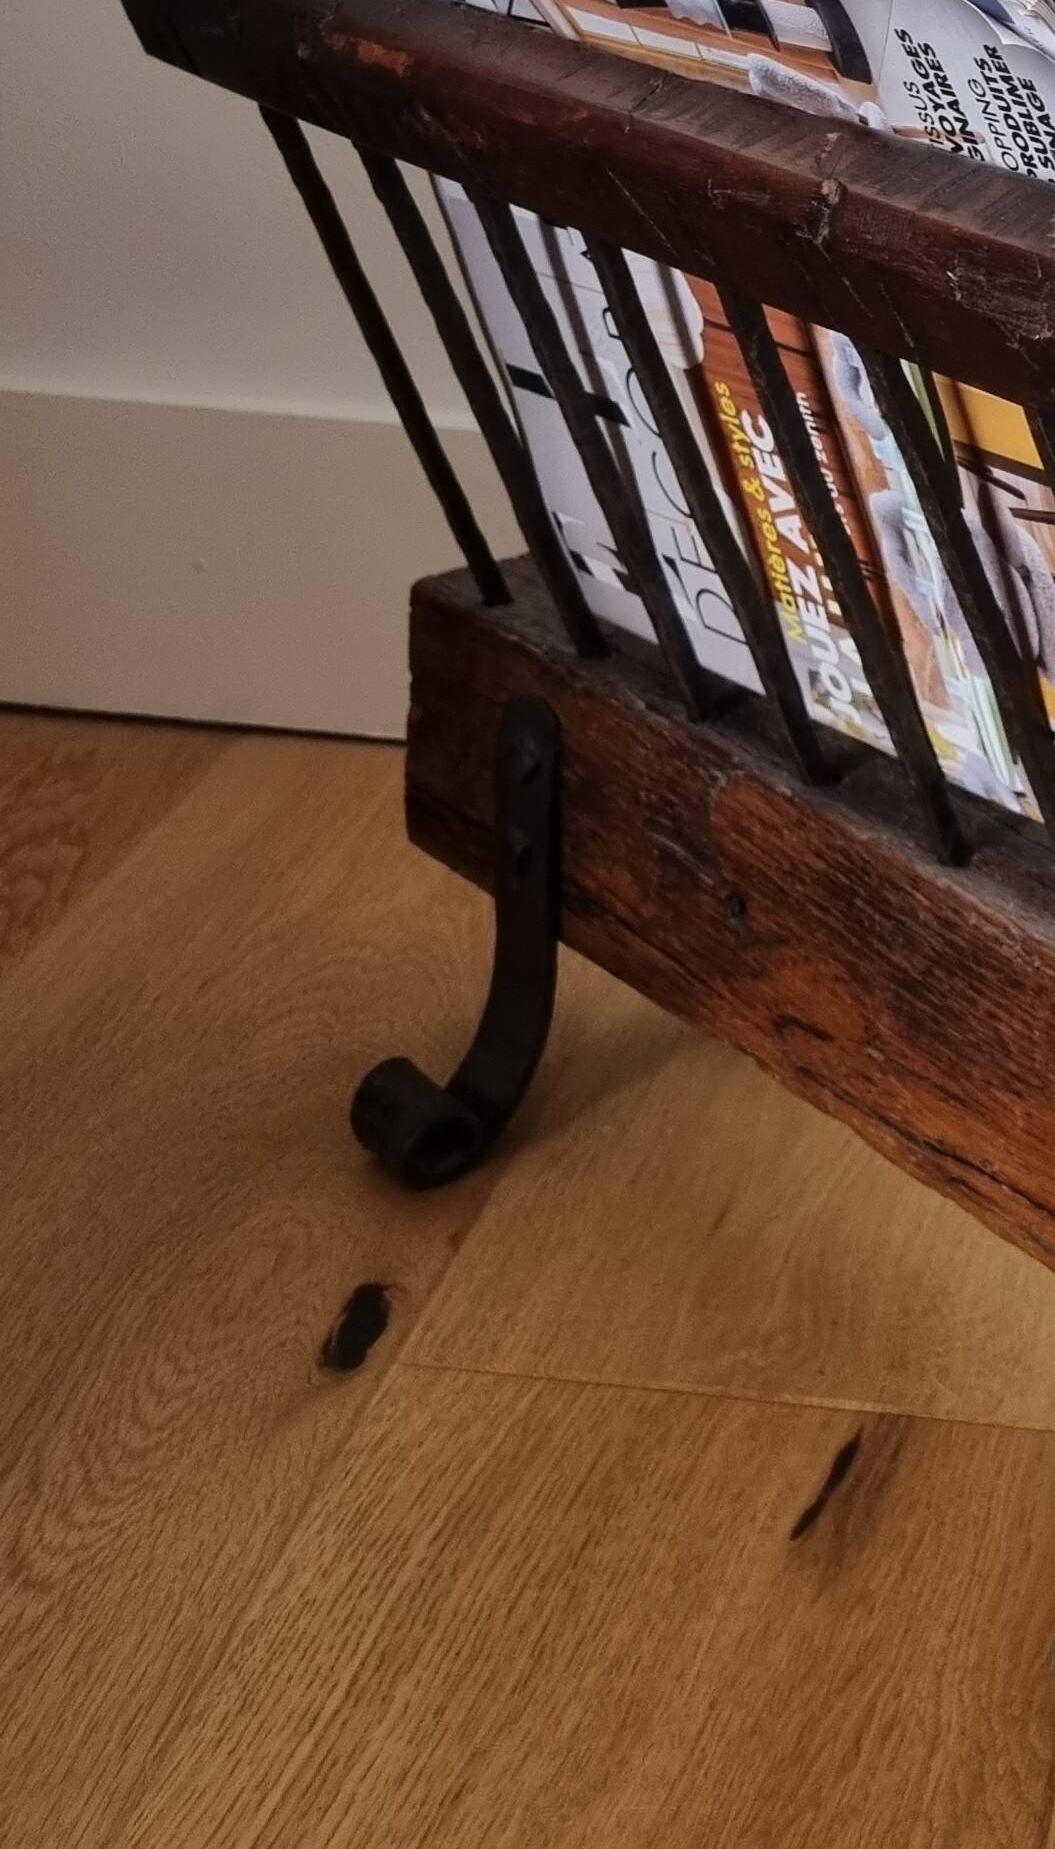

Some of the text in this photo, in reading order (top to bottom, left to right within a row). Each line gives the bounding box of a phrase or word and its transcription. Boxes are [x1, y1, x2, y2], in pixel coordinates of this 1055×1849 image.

[894, 28, 964, 154] VOYAGES
[904, 81, 943, 145] ISSUS
[917, 42, 985, 162] GINAIRES
[968, 79, 1019, 172] OPPING
[983, 44, 1055, 171] SUBLIMER
[715, 381, 755, 470] styles
[741, 409, 810, 554] AVEC
[742, 477, 765, 502] &
[787, 557, 862, 725] JOUEZ
